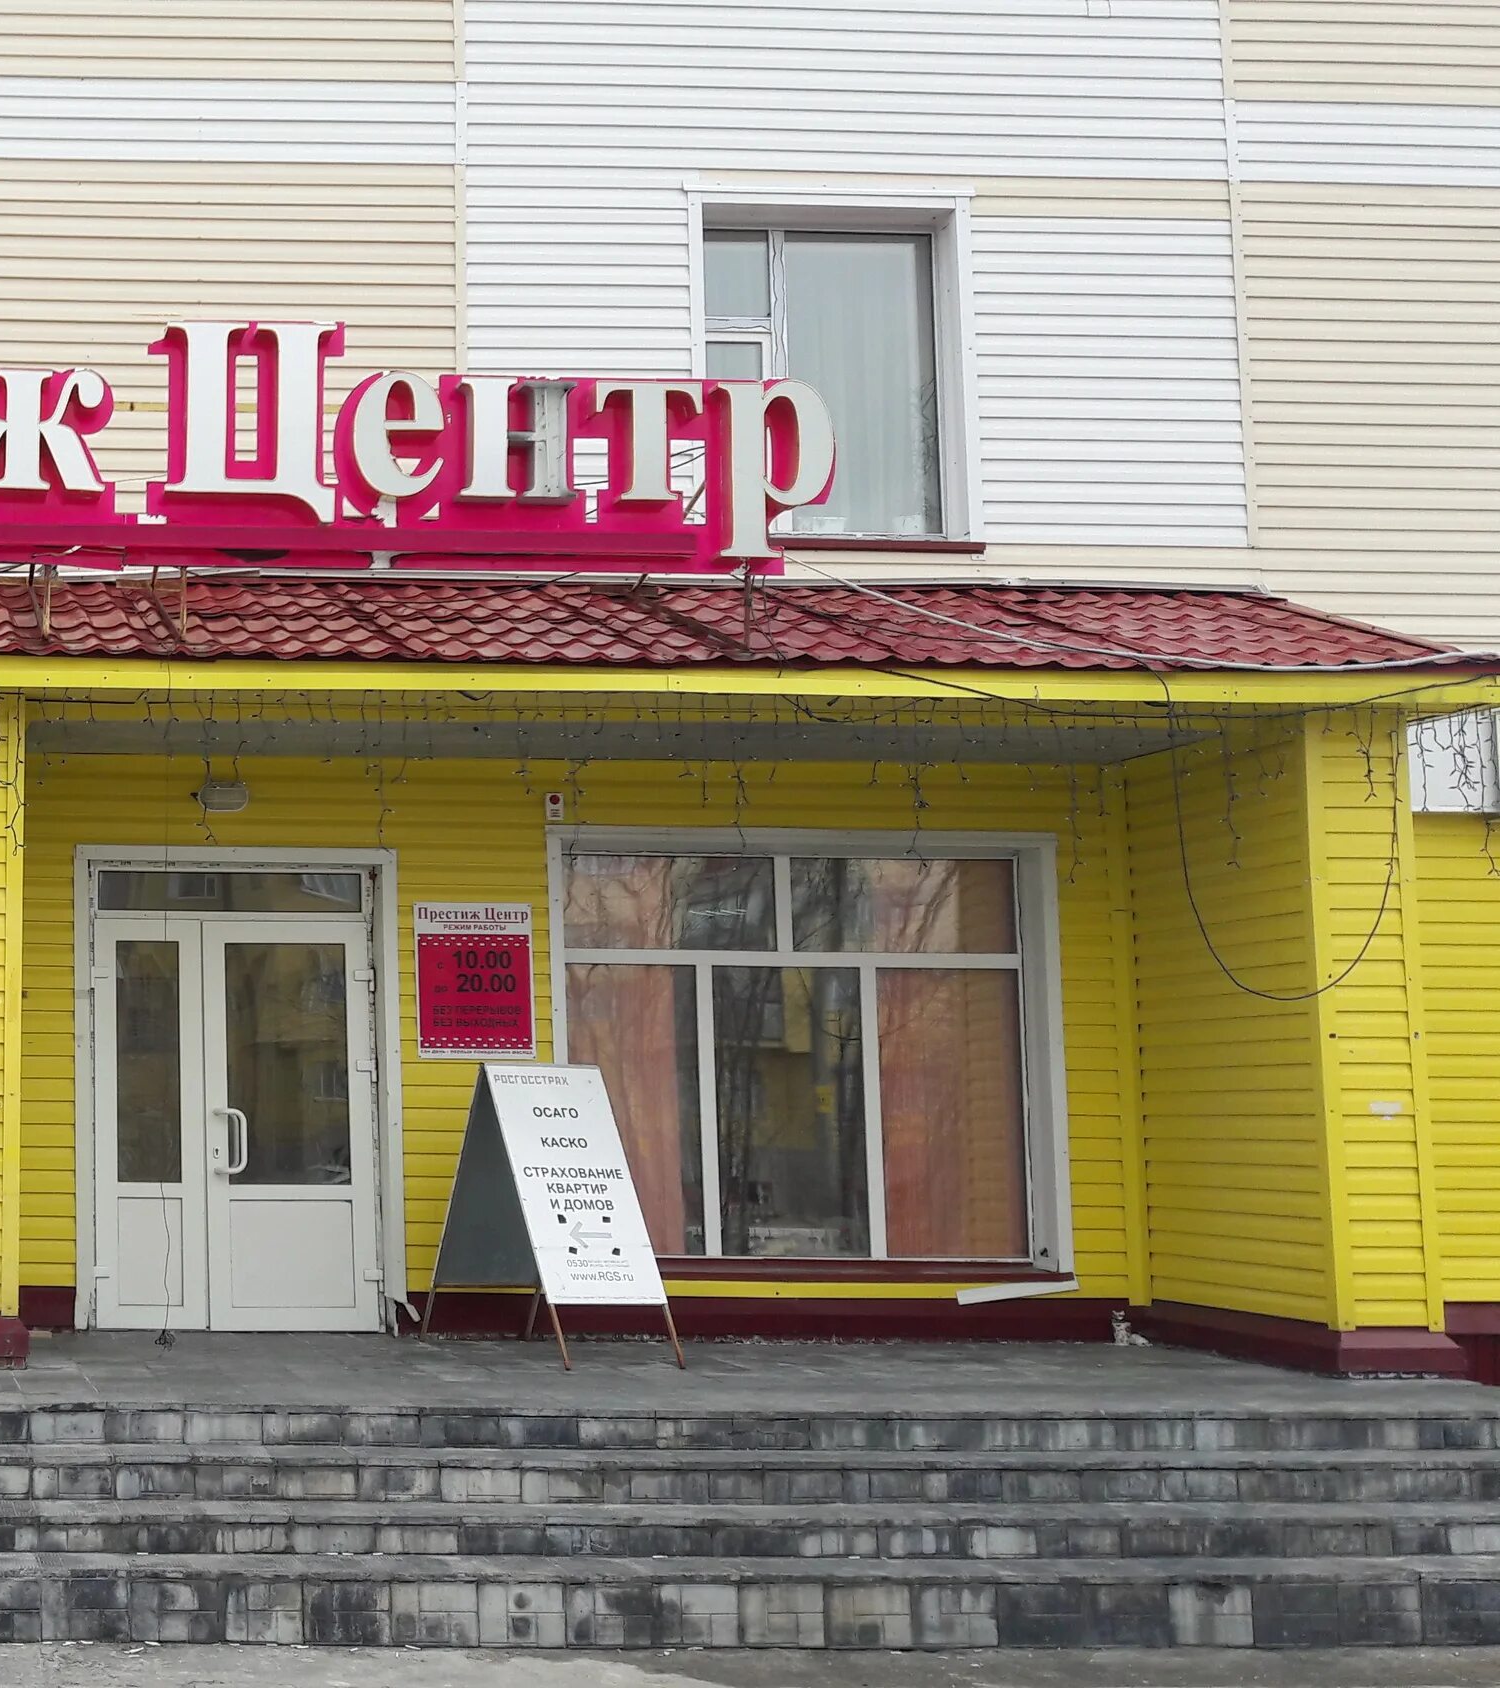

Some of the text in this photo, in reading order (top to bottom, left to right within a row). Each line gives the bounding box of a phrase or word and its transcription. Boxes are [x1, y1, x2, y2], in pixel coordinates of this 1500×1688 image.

[163, 320, 836, 558] Центр
[417, 906, 529, 924] Престиж Центр
[452, 950, 512, 970] 10.00
[456, 973, 517, 993] 20.00
[493, 1074, 569, 1086] РОСГОССТРАХ
[532, 1106, 579, 1119] ОСАГО
[540, 1136, 588, 1149] КАСКО
[522, 1166, 624, 1180] СТРАХОВАНИЕ
[546, 1182, 608, 1195] КВАРТИР
[550, 1198, 615, 1212] И ДОМОВ
[566, 1259, 589, 1268] 0530
[570, 1271, 635, 1282] www.RGS.ru
